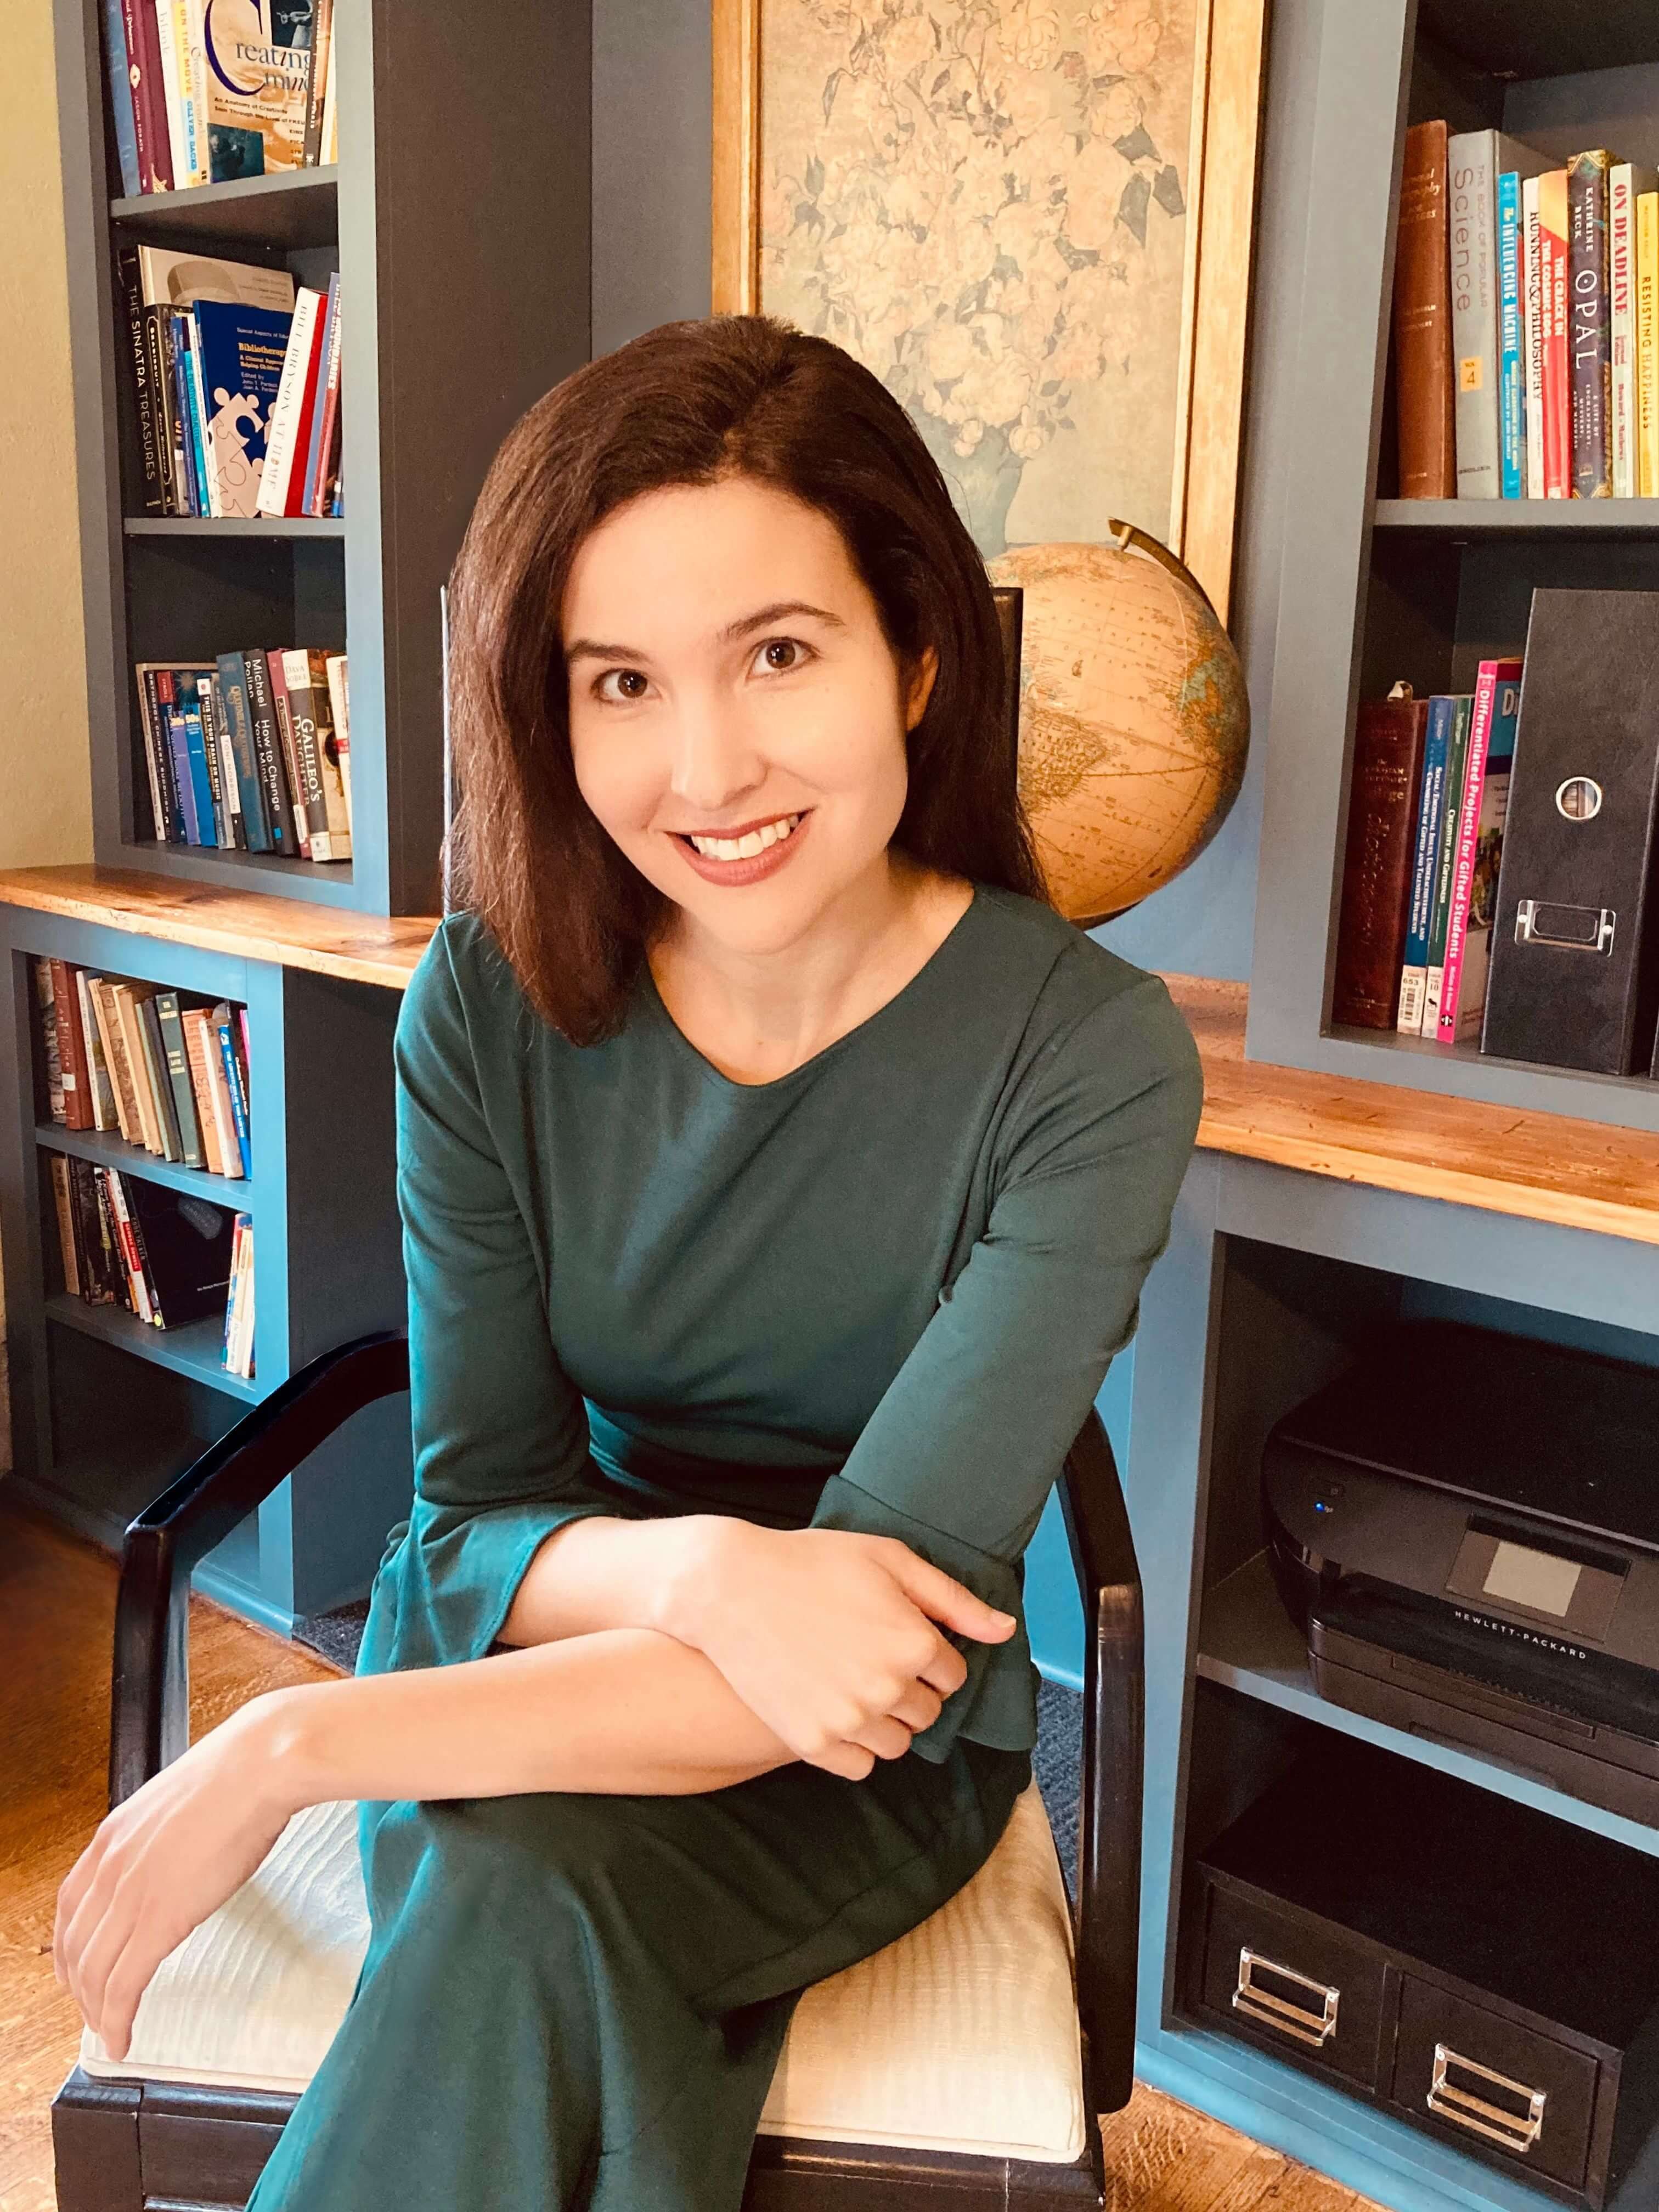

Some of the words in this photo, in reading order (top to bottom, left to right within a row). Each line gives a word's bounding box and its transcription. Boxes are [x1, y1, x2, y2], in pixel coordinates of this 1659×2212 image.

[180, 9, 187, 25] ON
[1477, 194, 1486, 228] BOOK
[1585, 187, 1594, 252] KATHRINE
[1614, 184, 1627, 210] ON
[1454, 168, 1474, 311] Science
[1479, 232, 1486, 246] OF
[1502, 223, 1515, 299] INFLUENCING
[1542, 240, 1552, 264] THE
[1479, 252, 1487, 308] POPULAR
[1542, 264, 1552, 311] COSMIC
[1555, 256, 1564, 279] THE
[1615, 216, 1627, 316] DEADLINE
[127, 285, 140, 317] THE
[1555, 280, 1564, 320] CRACK
[1575, 269, 1598, 369] OPAL
[1642, 276, 1651, 348] RESISTING
[294, 306, 308, 341] BILL
[1504, 303, 1516, 353] MACHINE
[1542, 312, 1552, 338] EGG
[1555, 321, 1564, 336] IN
[132, 321, 146, 388] SINATRA
[280, 347, 300, 413] BRYSON
[1466, 371, 1475, 384] 4
[1643, 354, 1652, 430] HAPPINESS
[139, 391, 156, 481] TREASURES
[275, 421, 286, 439] AT
[266, 445, 282, 490] HOME
[244, 661, 255, 699] Pollan
[252, 659, 267, 707] Michael
[149, 673, 159, 721] ORTHODOX
[155, 725, 163, 763] CHINESE
[255, 720, 263, 748] Your
[261, 719, 271, 747] How
[1469, 690, 1490, 782] Differentiated
[210, 743, 218, 764] BRAIN
[212, 768, 218, 776] ON
[258, 752, 269, 783] Mind
[266, 750, 273, 762] to
[301, 718, 322, 802] GALILEO'S
[227, 763, 236, 810] MORRISON
[268, 765, 280, 811] Change
[1463, 784, 1480, 836] Projects
[1460, 839, 1473, 858] for
[1455, 861, 1470, 901] Gifted
[1449, 902, 1465, 959] Students
[125, 1222, 133, 1245] GEORGE
[130, 1246, 139, 1269] ORWELL
[1455, 1611, 1586, 1660] HEWLETT-PACKARD
